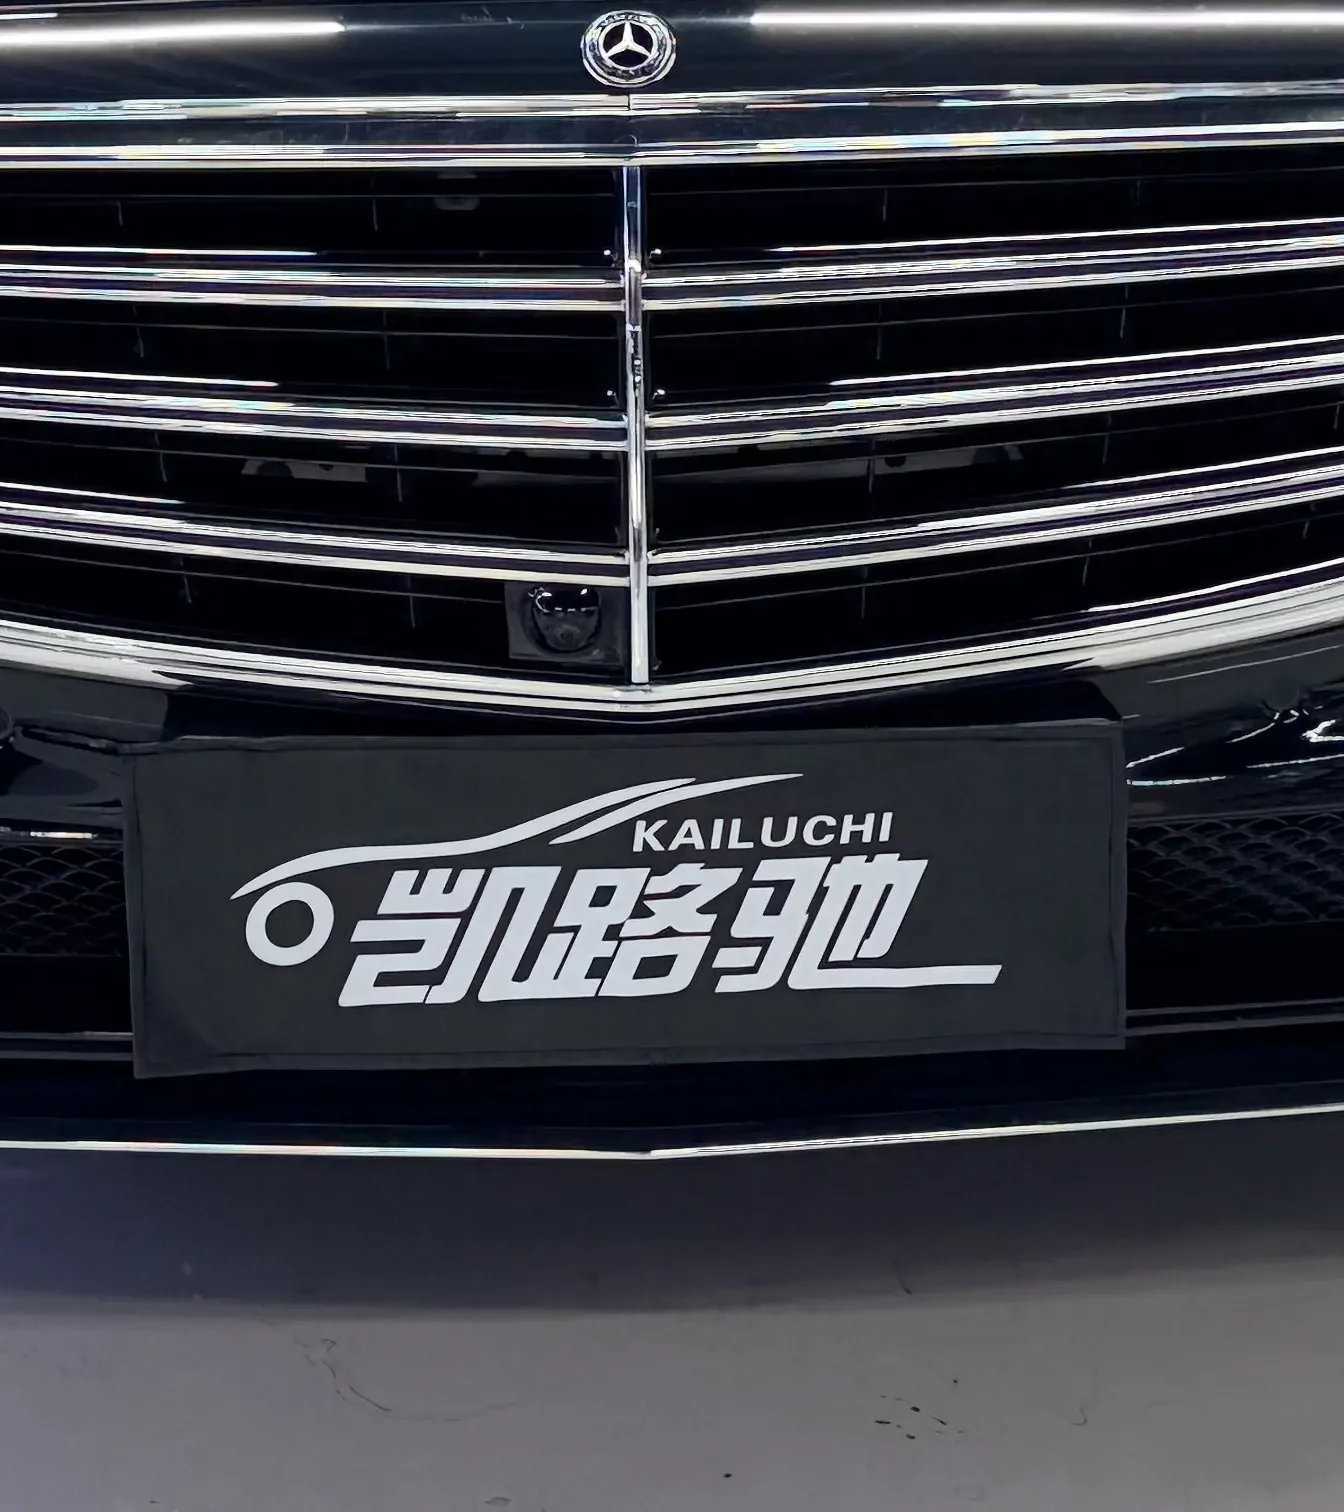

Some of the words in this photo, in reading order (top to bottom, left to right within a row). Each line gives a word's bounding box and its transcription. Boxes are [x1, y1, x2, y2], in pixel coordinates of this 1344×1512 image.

[631, 811, 894, 854] KAILUCHI
[337, 856, 1003, 1007] 凯路驰
